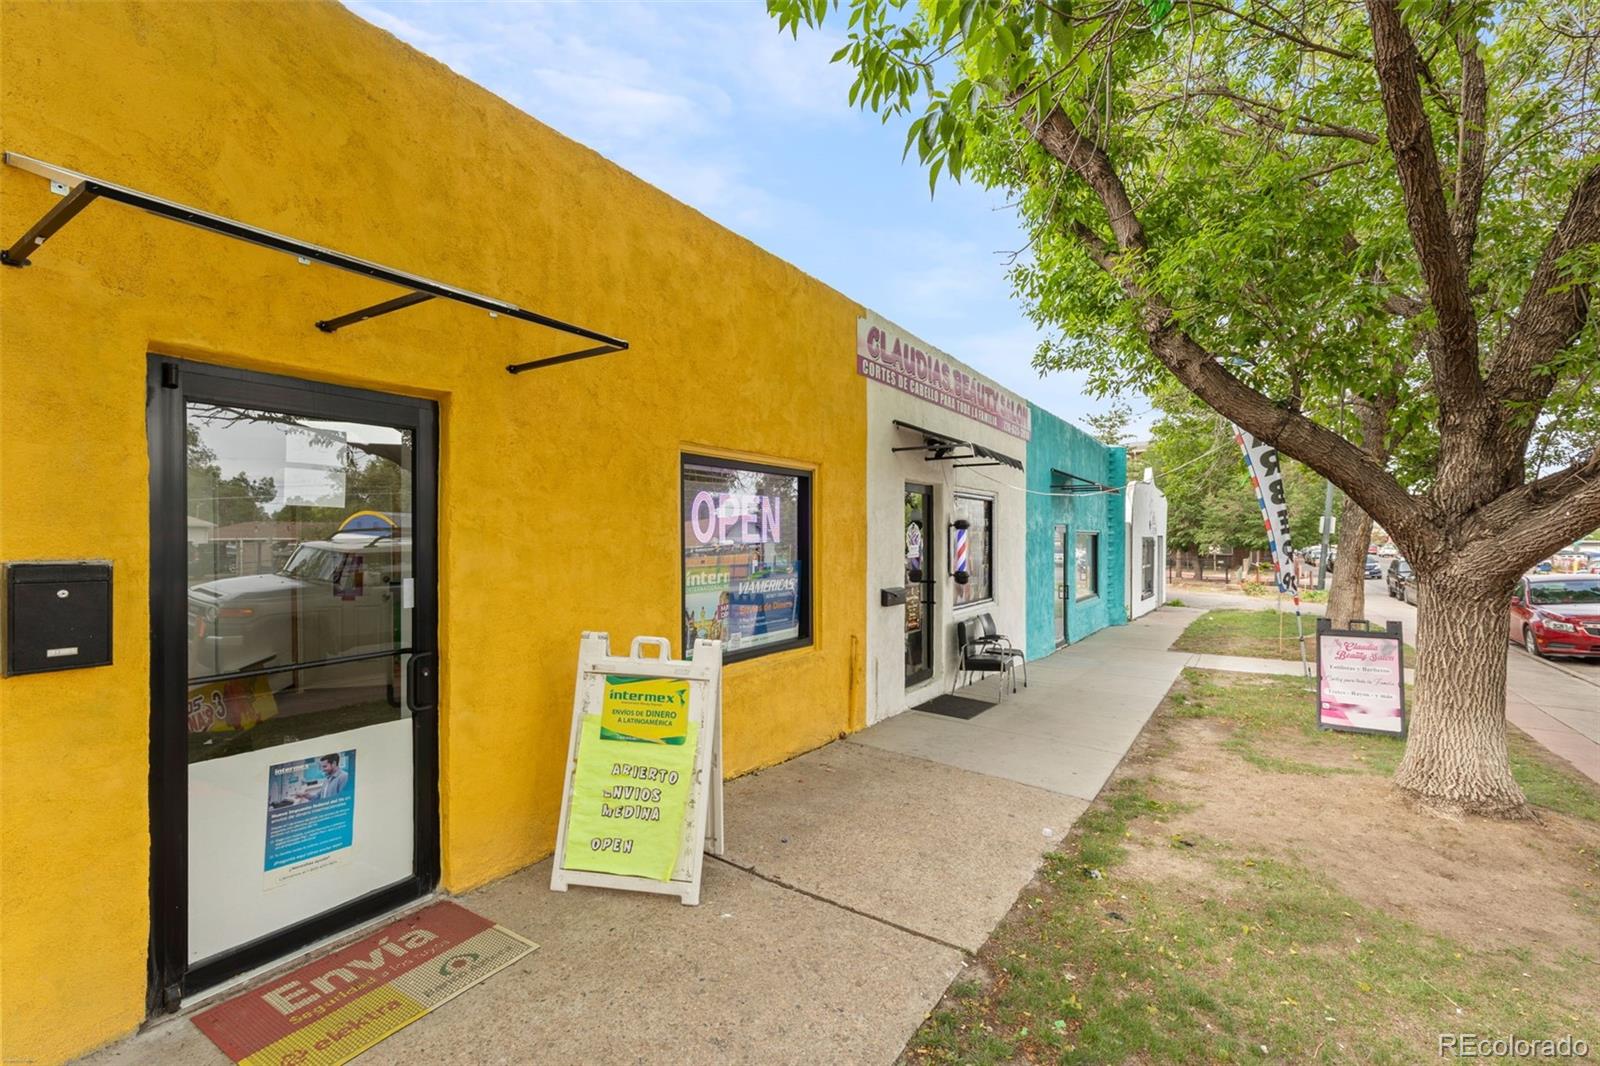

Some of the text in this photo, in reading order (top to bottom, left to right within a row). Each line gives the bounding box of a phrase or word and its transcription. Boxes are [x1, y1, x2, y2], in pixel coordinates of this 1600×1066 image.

[862, 359, 896, 385] CORTES
[898, 374, 908, 390] DE
[909, 379, 939, 404] CABELLO
[940, 391, 956, 410] PARA
[866, 326, 950, 391] CLAUDIAS
[953, 369, 999, 412] BEAUTY
[691, 490, 780, 544] OPEN
[738, 578, 795, 595] VIAMERICAS
[609, 689, 674, 704] intermex
[635, 709, 643, 717] DE
[645, 709, 677, 720] DINERO
[591, 838, 633, 854] OPEN
[261, 925, 440, 1016] Envía
[286, 975, 380, 1026] Seguridad
[308, 996, 404, 1052] elektra
